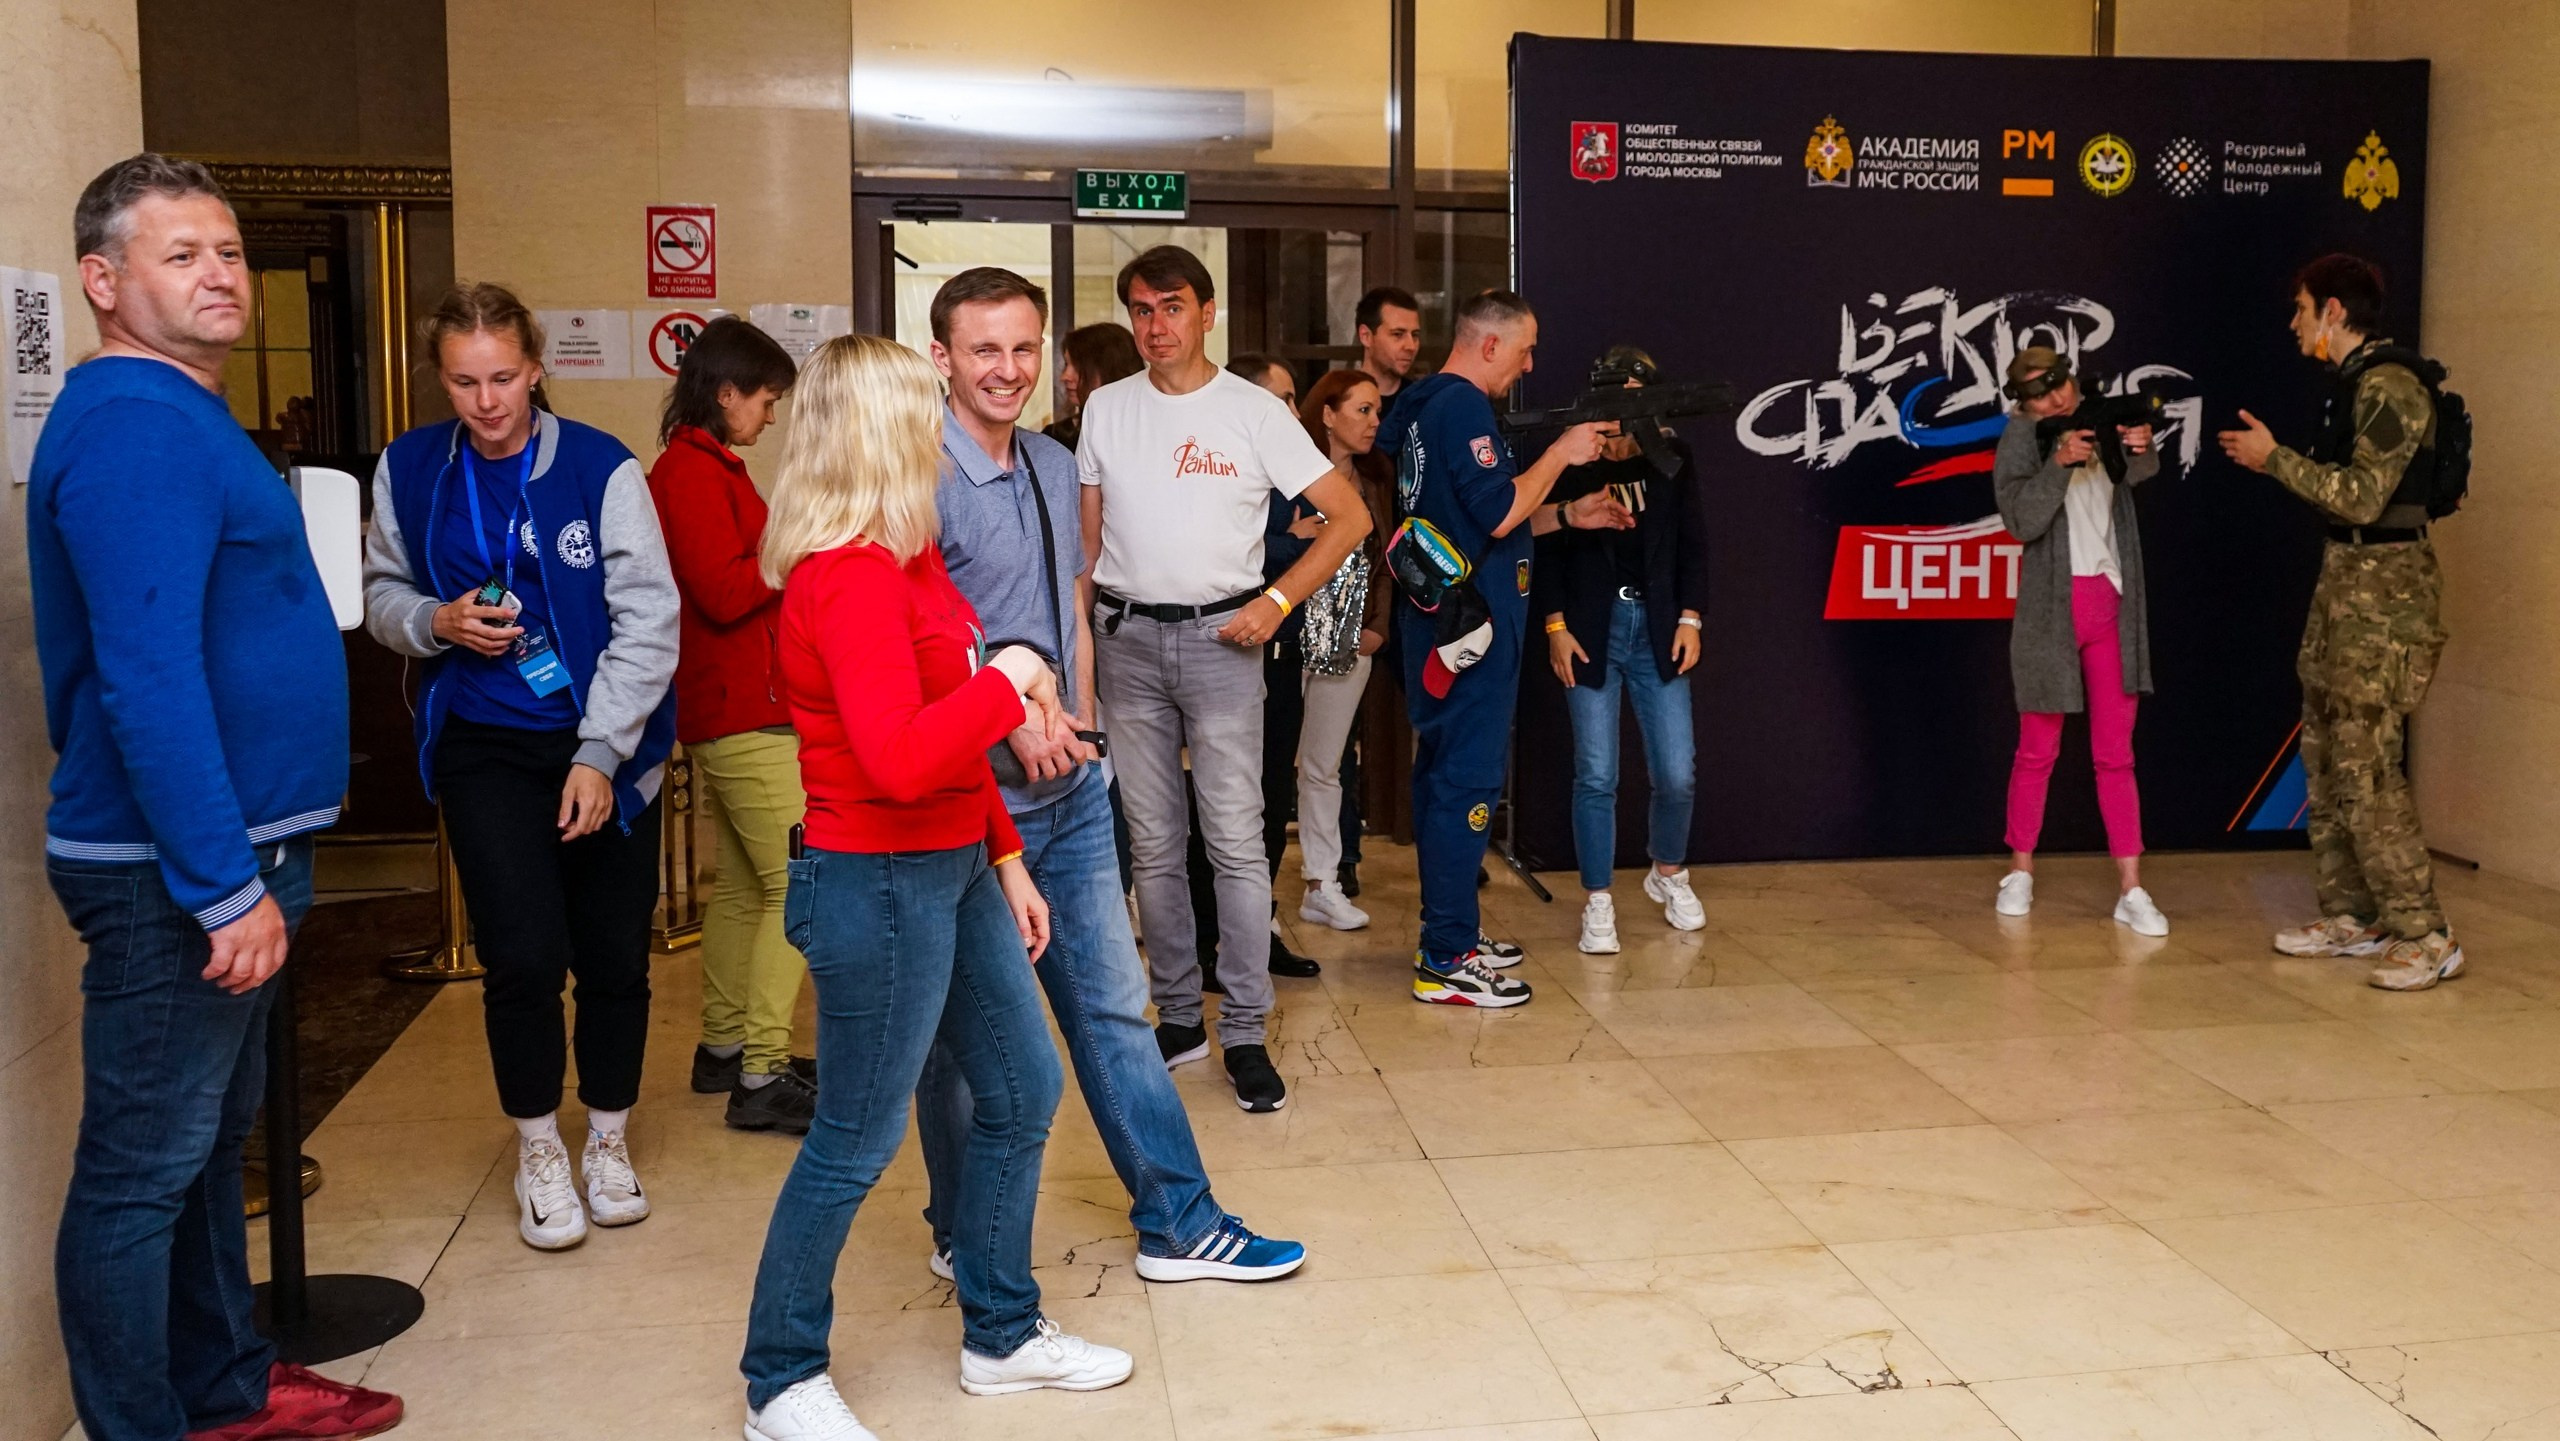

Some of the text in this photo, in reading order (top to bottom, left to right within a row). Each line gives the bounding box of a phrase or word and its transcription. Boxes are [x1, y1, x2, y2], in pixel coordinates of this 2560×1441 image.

[1625, 124, 1678, 135] КОМИТЕТ
[1625, 138, 1762, 152] ОБЩЕСТВЕННЫХ СВЯЗЕЙ
[1859, 136, 1979, 159] АКАДЕМИЯ
[2225, 140, 2306, 159] Ресурсный
[1625, 152, 1783, 166] И МОЛОДЕЖНОЙ ПОЛИТИКИ
[1858, 158, 1979, 173] ГРАЖДАНСКОЙ ЗАЩИТЫ
[1625, 166, 1722, 179] ГОРОДА МОСКВЫ
[2224, 160, 2322, 177] Молодежный
[1086, 173, 1176, 192] ВЫХОД
[1858, 171, 1979, 190] МЧС РОССИИ
[2223, 178, 2269, 197] Центр
[1098, 193, 1163, 208] EXIT
[658, 275, 708, 286] НЕ КУРИТЬ
[655, 285, 712, 295] NO SMOKING
[1862, 544, 2024, 610] ЦЕНТ
